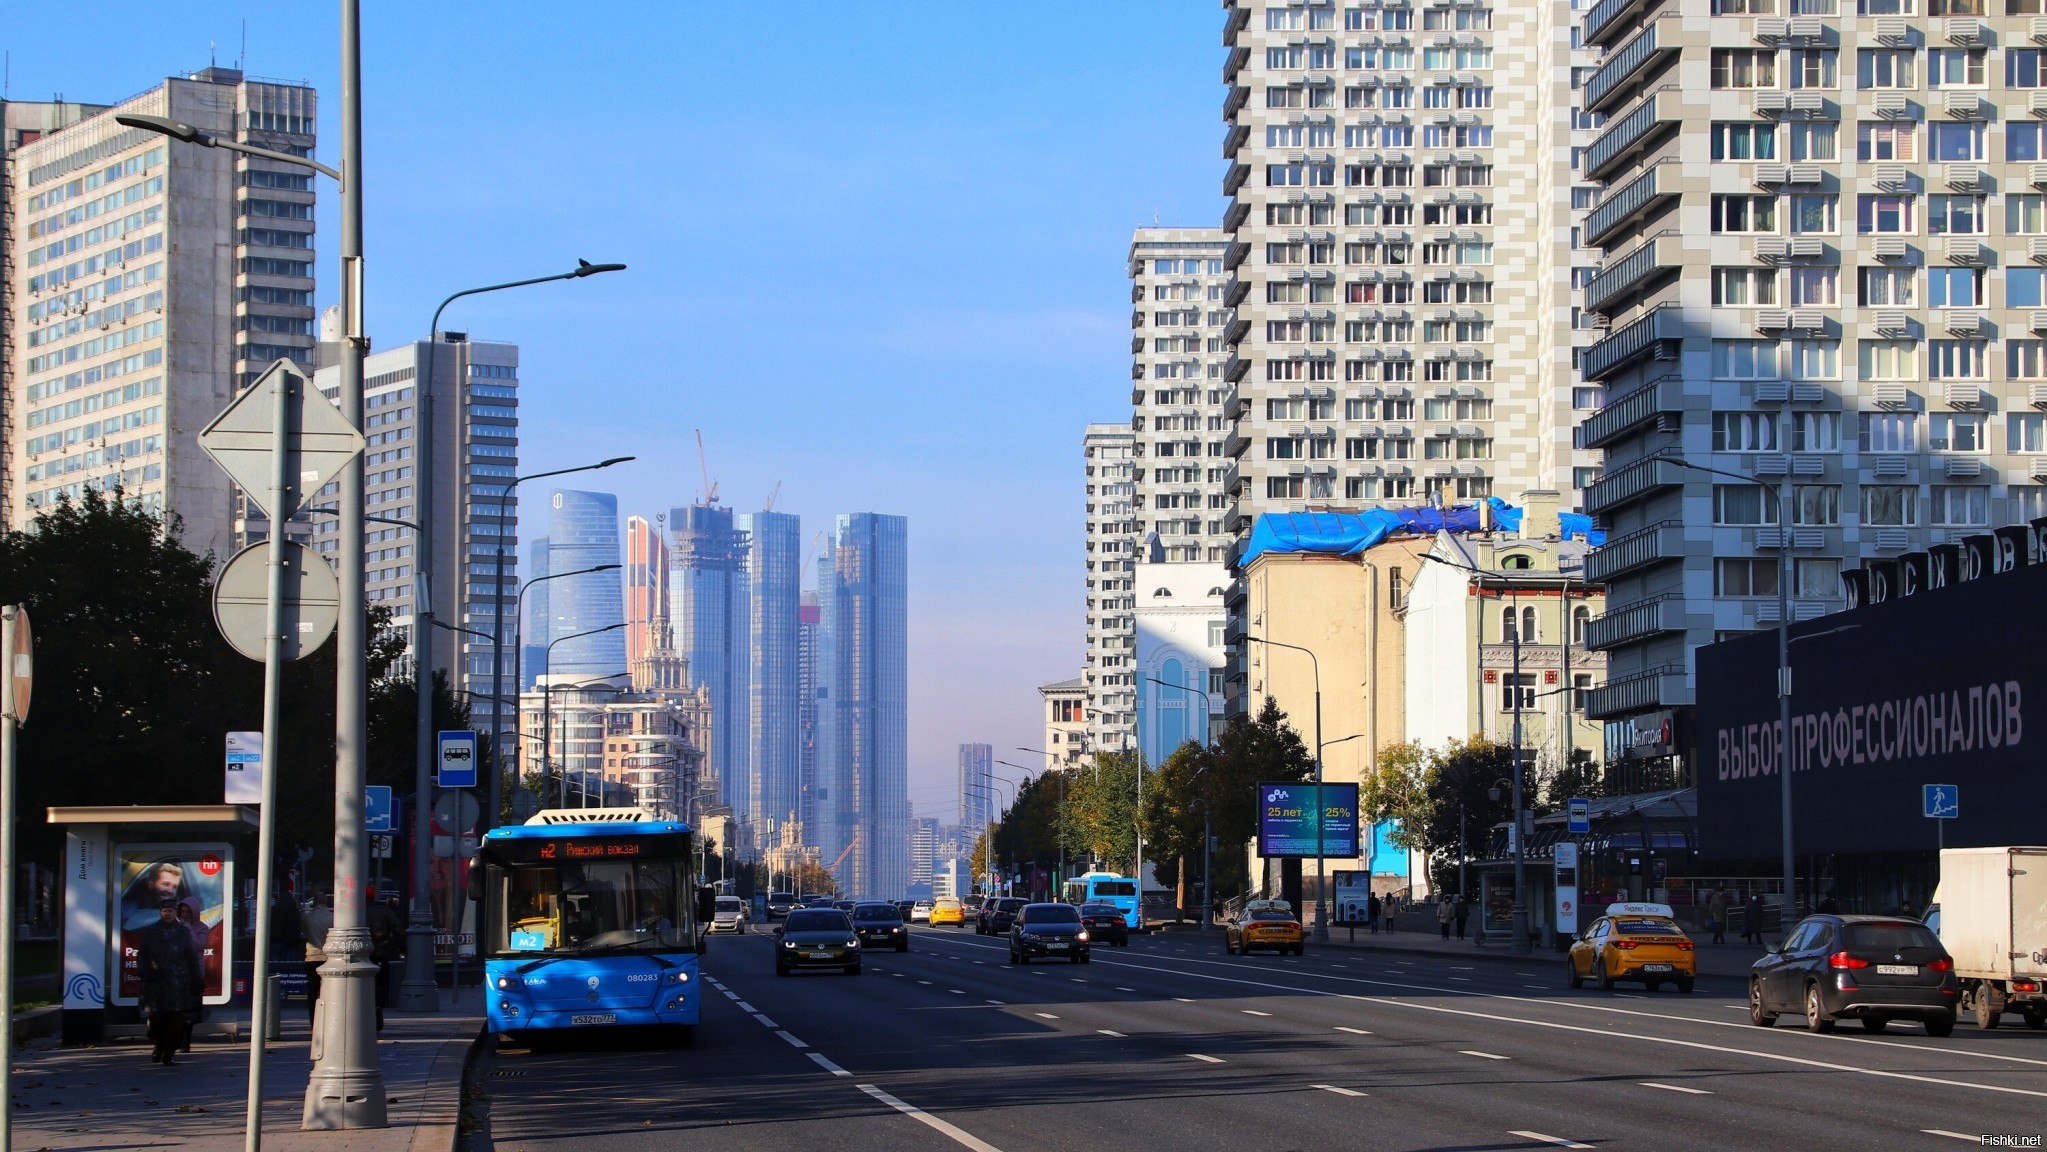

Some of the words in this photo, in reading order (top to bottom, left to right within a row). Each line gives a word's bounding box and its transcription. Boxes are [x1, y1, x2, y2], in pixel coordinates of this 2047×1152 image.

[1718, 719, 1783, 781] ВЫБОР
[1792, 680, 2023, 772] ПРОФЕССИОНАЛОВ
[1267, 807, 1281, 817] 25
[1282, 809, 1303, 817] лет
[1325, 807, 1351, 818] 25%
[607, 844, 639, 855] вокзал
[202, 859, 217, 869] hh
[78, 864, 87, 880] Дом
[1623, 904, 1644, 912] Яндекс
[1644, 905, 1660, 913] Такси
[518, 936, 537, 947] м2
[627, 973, 658, 982] 080283
